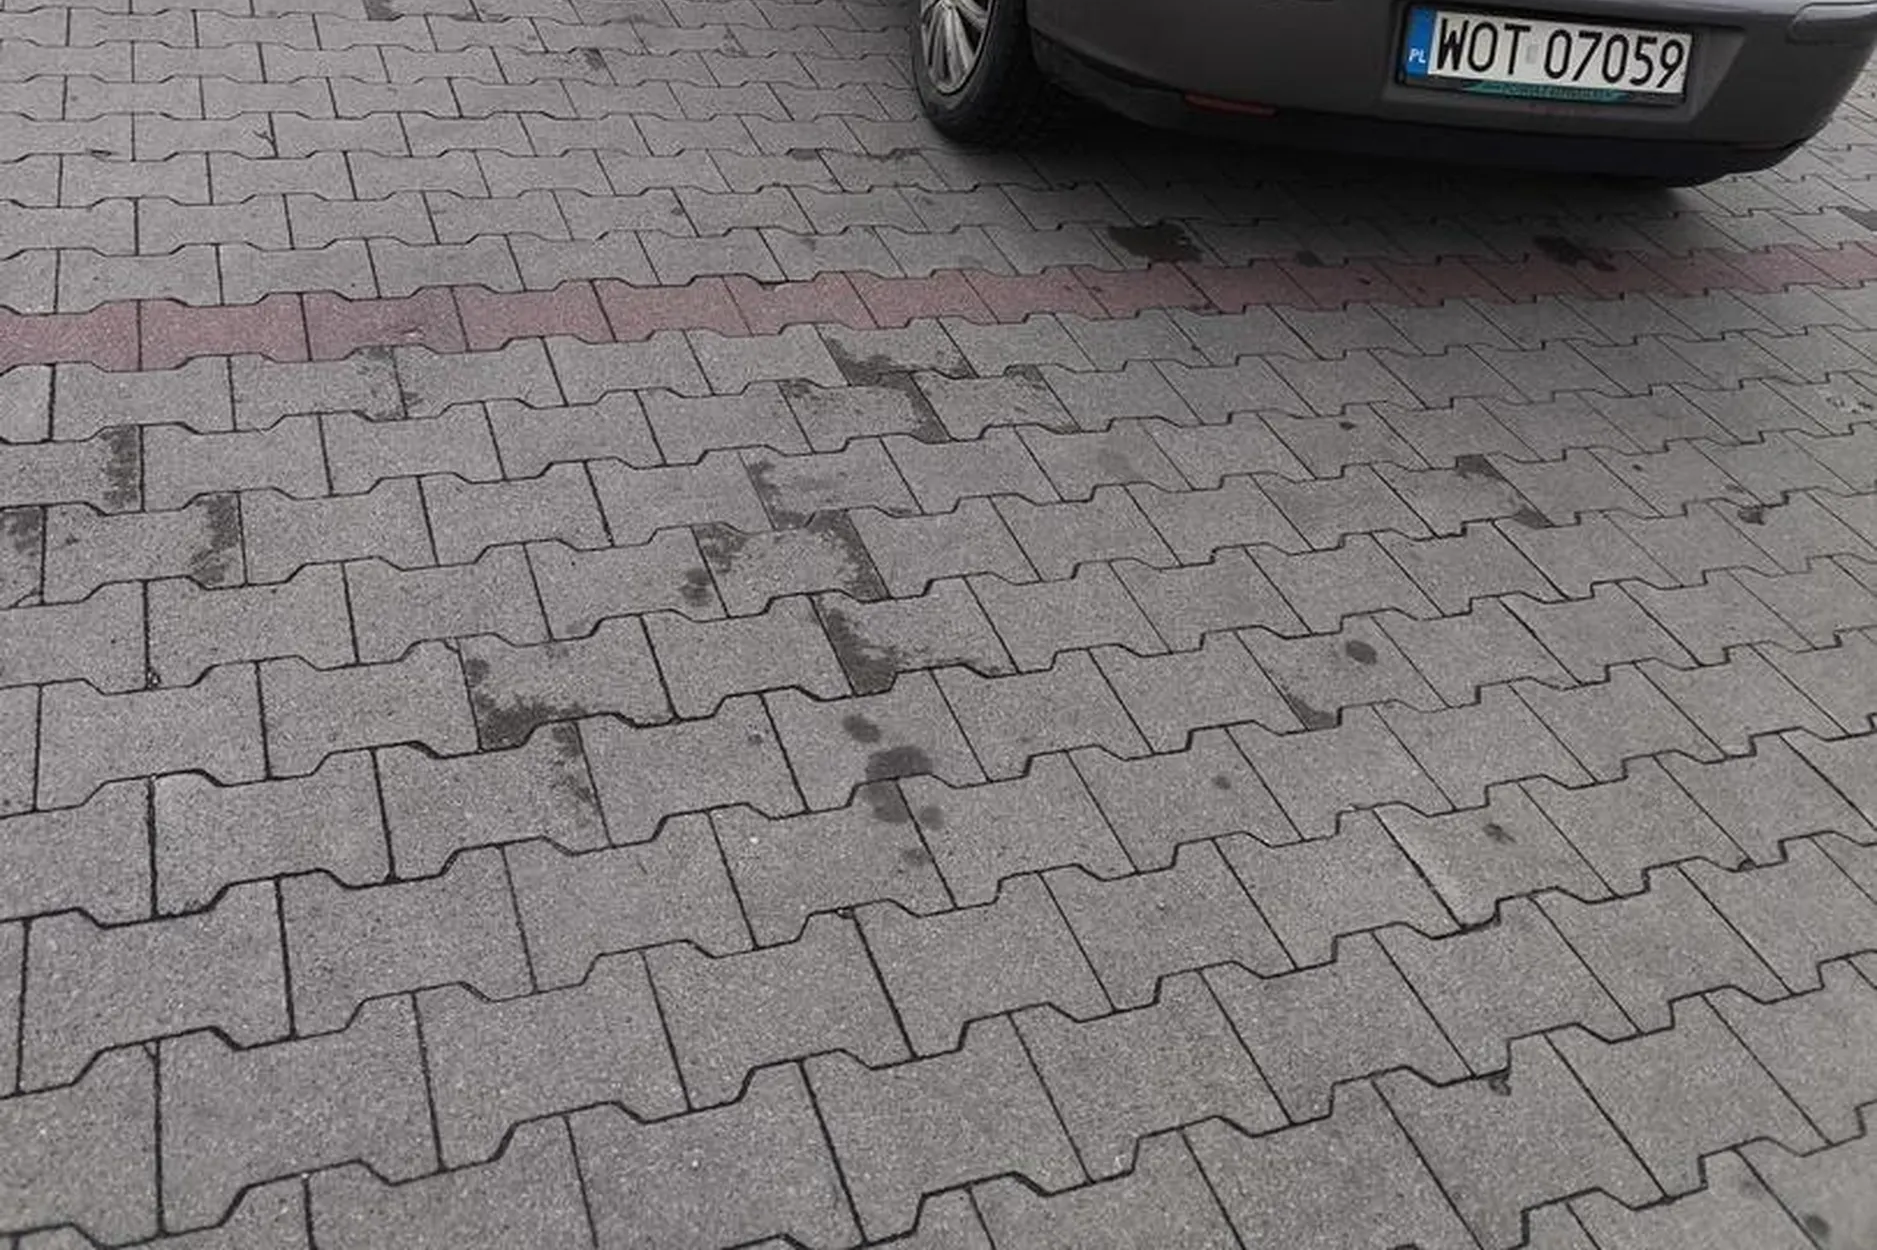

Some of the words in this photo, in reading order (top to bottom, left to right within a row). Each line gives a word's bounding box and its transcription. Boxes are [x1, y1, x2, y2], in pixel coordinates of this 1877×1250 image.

[1408, 48, 1427, 64] PL
[1436, 17, 1531, 75] WOT
[1543, 28, 1685, 88] 07059
